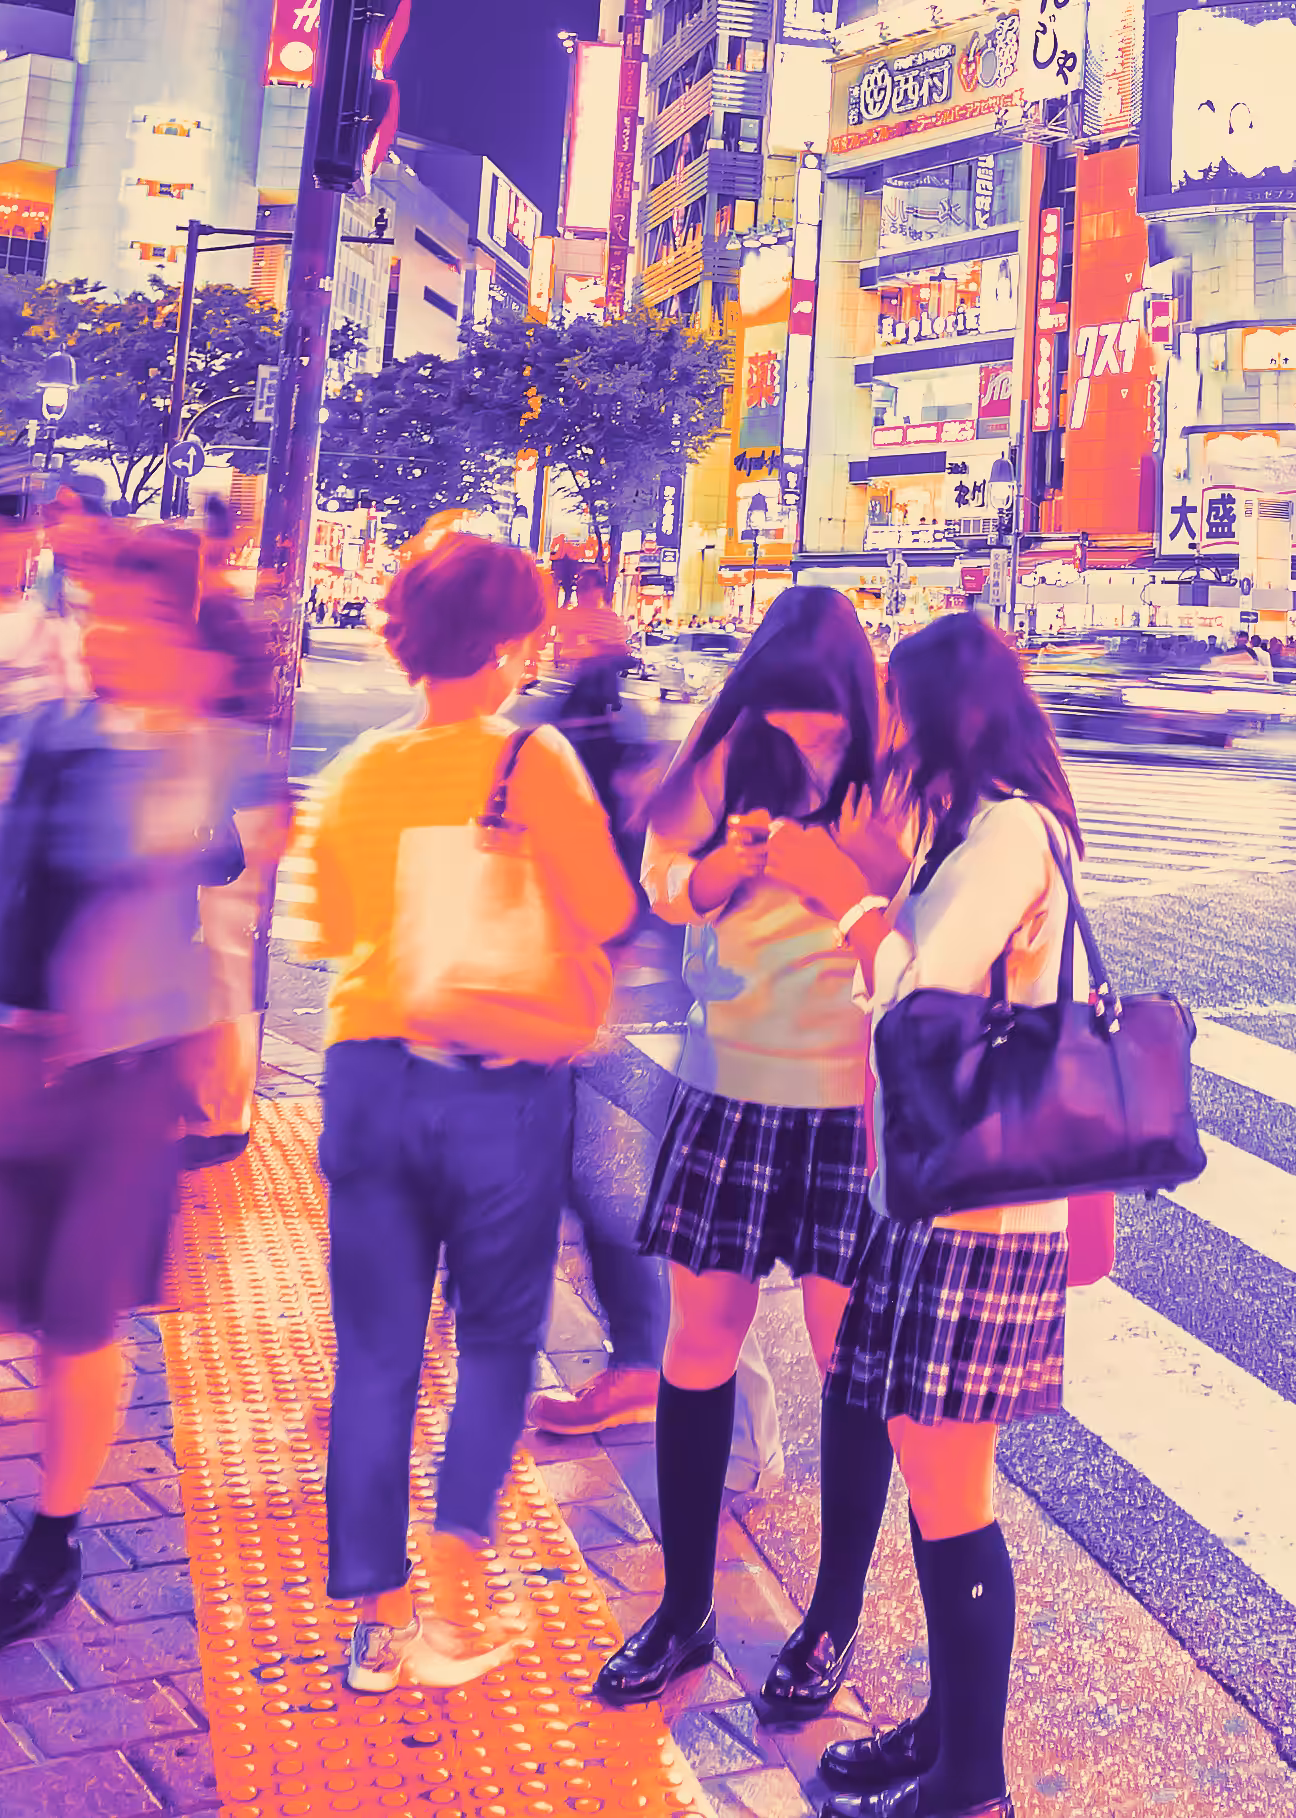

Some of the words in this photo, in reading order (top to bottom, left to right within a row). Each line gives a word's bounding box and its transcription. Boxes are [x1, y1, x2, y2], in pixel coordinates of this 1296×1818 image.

[1032, 0, 1078, 86] じゃ
[747, 350, 781, 409] 薬
[980, 370, 1013, 408] JTB
